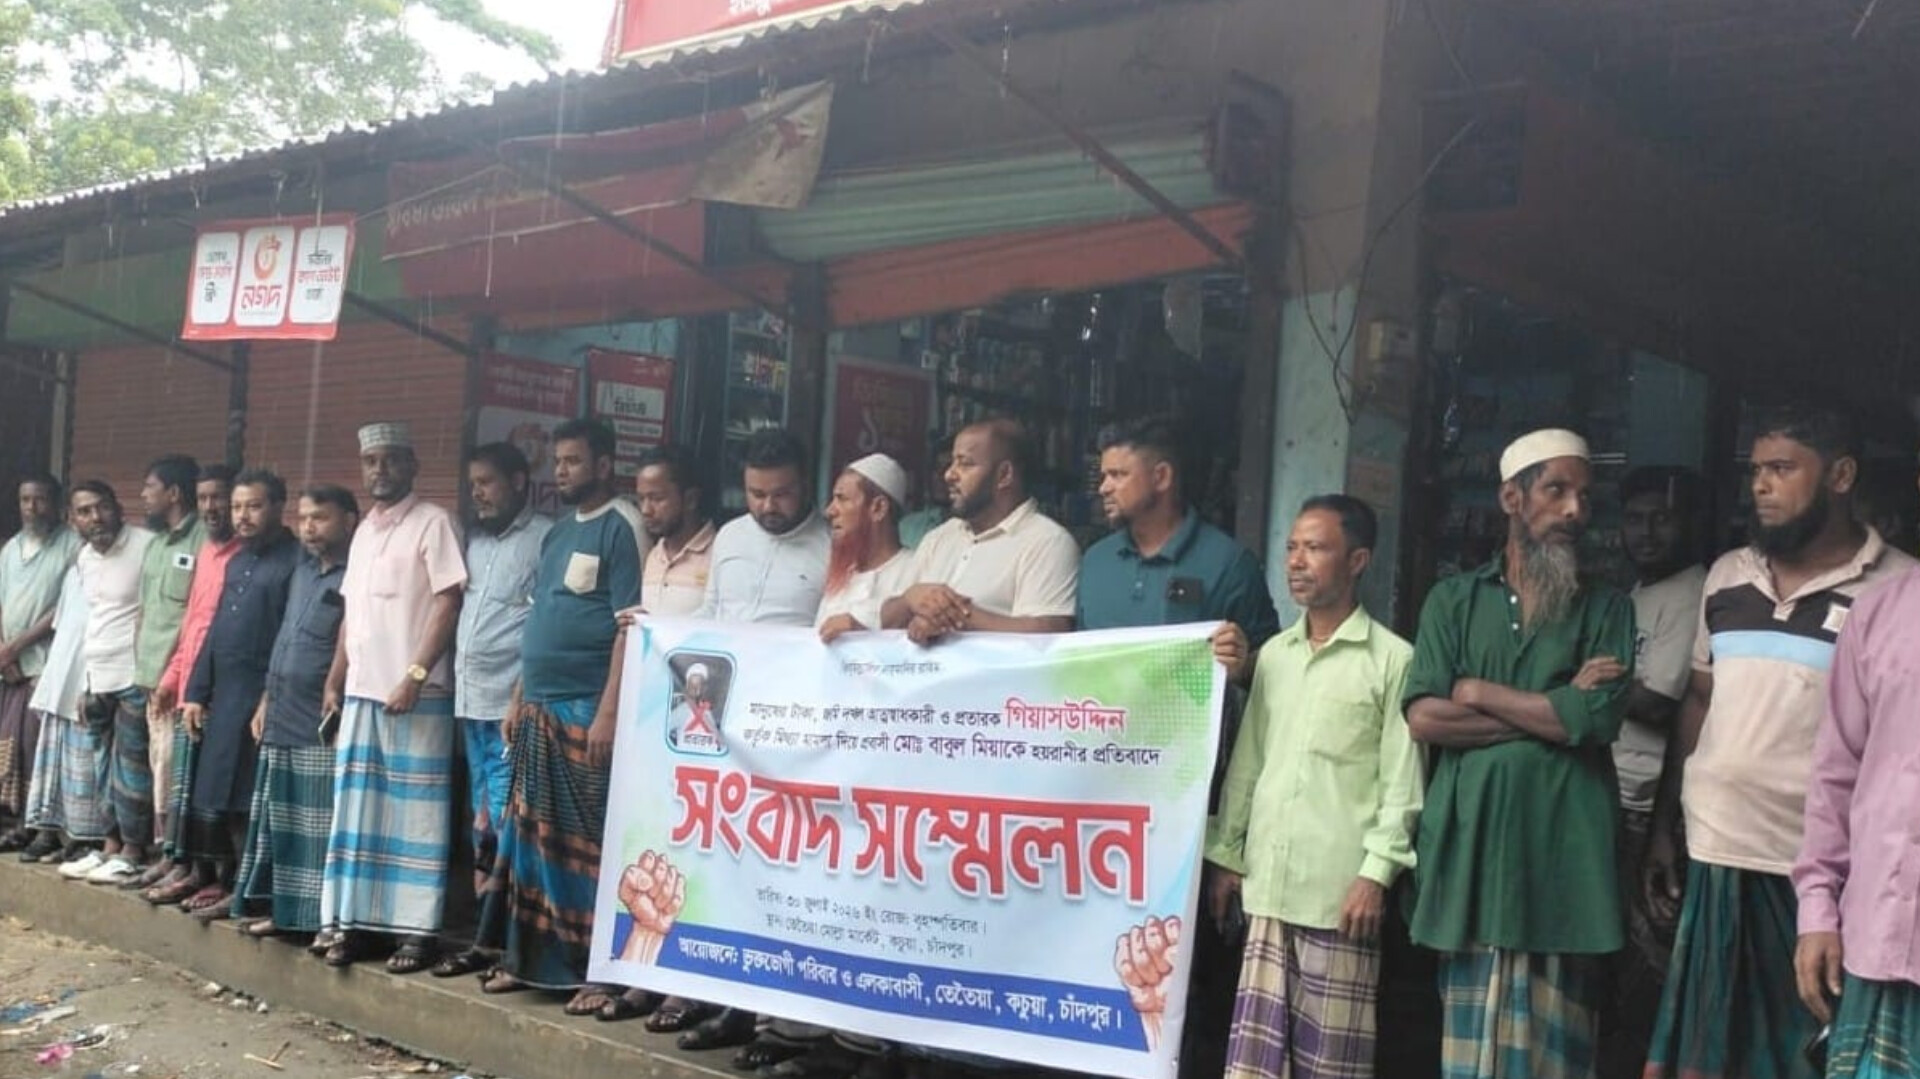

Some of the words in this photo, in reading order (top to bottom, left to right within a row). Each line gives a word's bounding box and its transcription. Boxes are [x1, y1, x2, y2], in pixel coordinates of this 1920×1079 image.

[240, 285, 283, 309] নগদ
[954, 710, 1001, 727] প্রতারক
[1005, 696, 1127, 732] গিয়াসউদ্দিন
[928, 736, 966, 758] বাবুল
[971, 732, 1028, 759] মিয়াকে
[1031, 740, 1087, 763] হয়রানীর
[1092, 743, 1162, 766] প্রতিবাদে
[672, 765, 841, 870] সংবাদ
[852, 786, 1152, 905] সম্মেলন
[797, 955, 838, 985] পরিবার
[842, 970, 854, 988] ও
